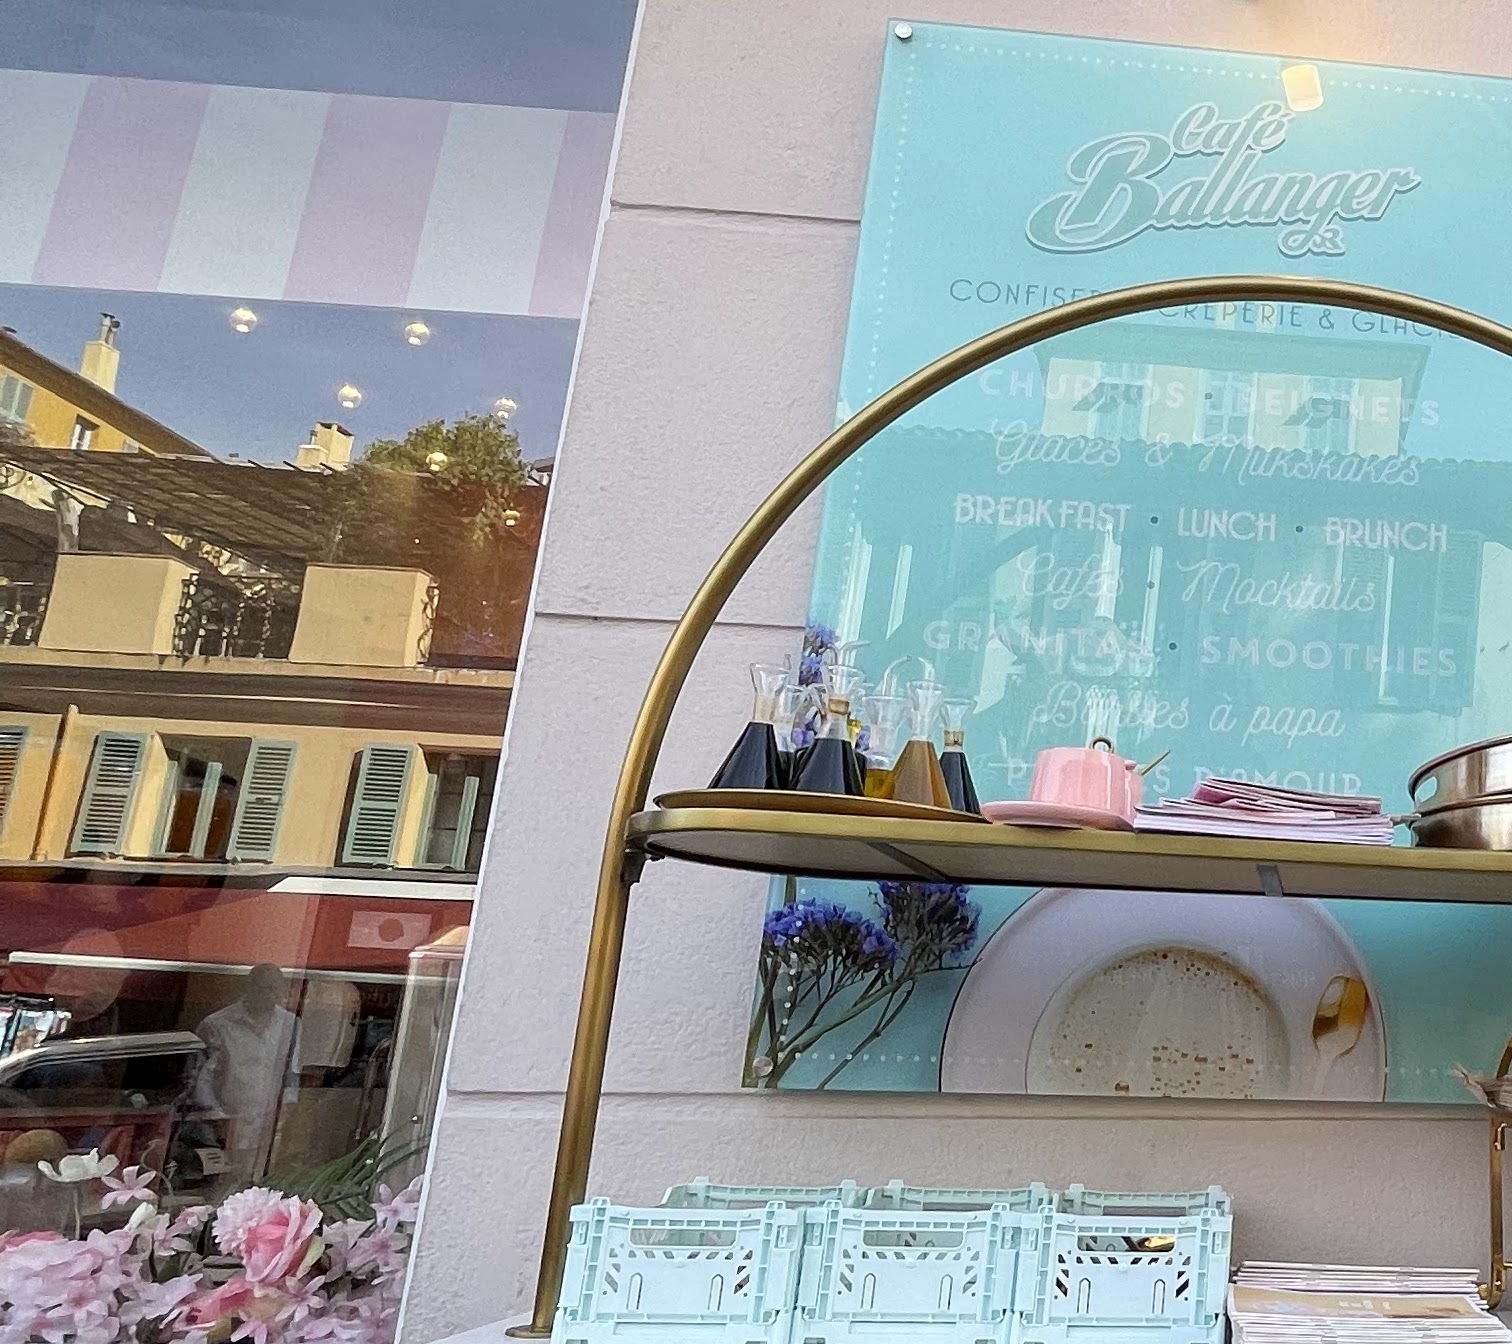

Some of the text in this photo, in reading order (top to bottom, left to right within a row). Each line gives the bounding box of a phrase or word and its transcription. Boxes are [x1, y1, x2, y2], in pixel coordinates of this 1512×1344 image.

[1170, 101, 1296, 156] Café
[1025, 130, 1422, 258] Ballanger
[949, 278, 1102, 307] CONFISE
[1318, 308, 1336, 330] &
[977, 369, 1186, 409] CHURROS
[991, 418, 1122, 475] Glaces
[1195, 433, 1422, 486] Milkshakes
[953, 493, 1448, 553] BREAKFAST LUNCH BRUNCH
[1177, 558, 1376, 615] Mocktails
[1200, 635, 1457, 677] SMOOTHIES
[1208, 692, 1238, 733] à
[1240, 705, 1347, 749] papa
